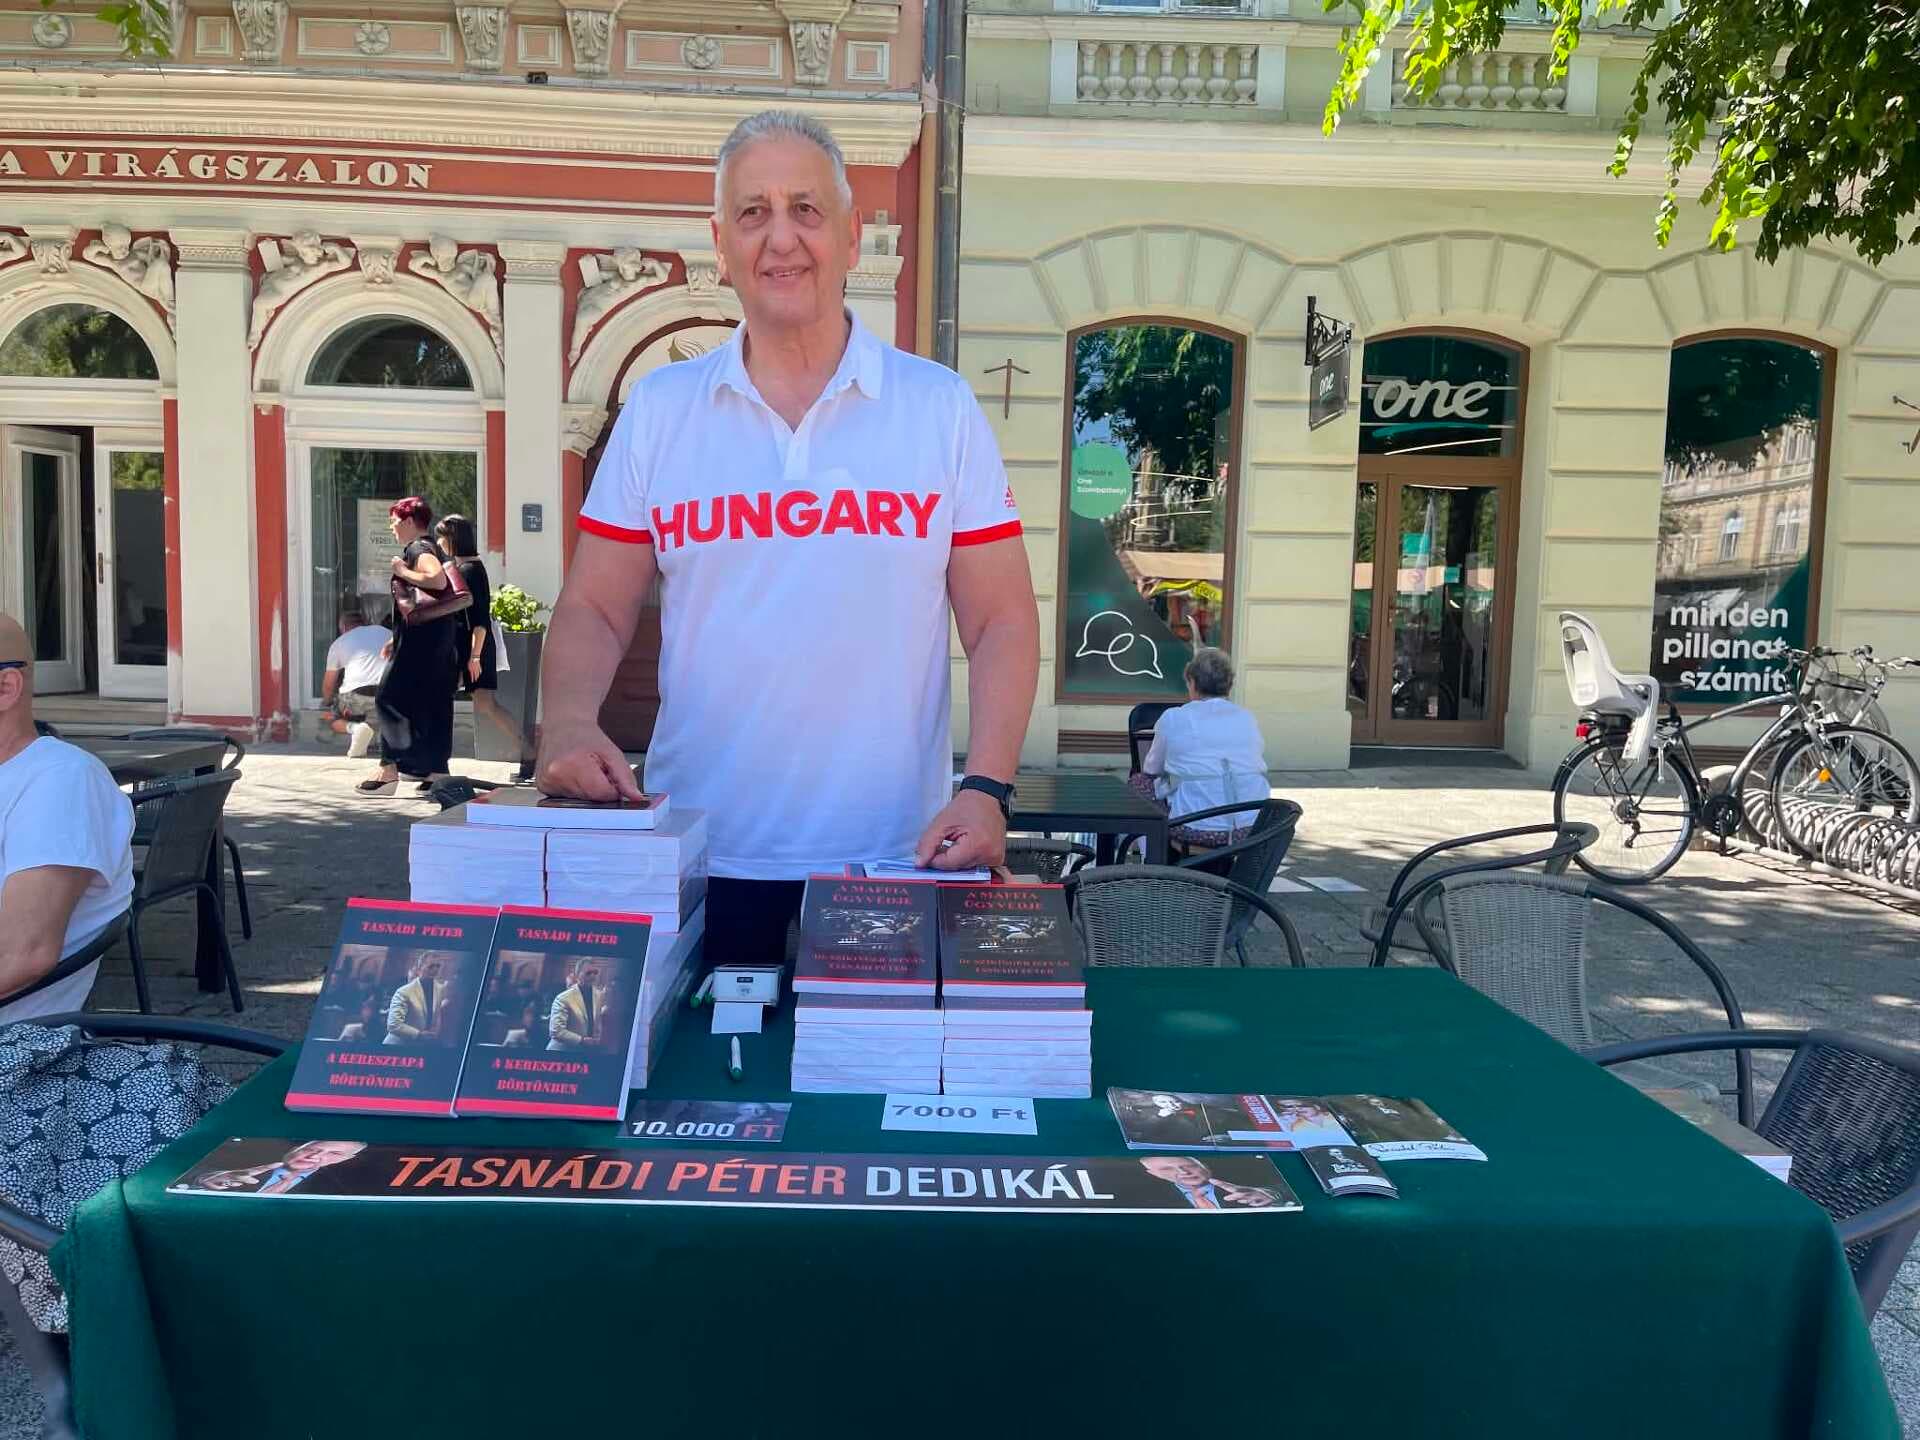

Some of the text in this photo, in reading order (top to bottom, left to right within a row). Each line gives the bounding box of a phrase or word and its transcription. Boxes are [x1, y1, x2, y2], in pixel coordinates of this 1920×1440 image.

[46, 148, 433, 189] VIRÁGSZALON
[1320, 372, 1334, 396] one
[1373, 379, 1491, 419] one
[651, 489, 943, 552] HUNGARY
[1670, 600, 1788, 629] minden
[1662, 632, 1787, 664] pillanat
[1680, 665, 1787, 692] számít
[361, 920, 464, 938] TASNÁDI PÉTER
[517, 927, 619, 945] TASNÁDI PÉTER
[326, 1053, 425, 1069] A KERESZTAPA
[492, 1058, 590, 1075] A KERESZTAPA
[892, 1104, 1029, 1121] 7000 Ft
[631, 1119, 780, 1139] 10.000 FT
[388, 1154, 1115, 1200] TASNÁDI PÉTER DEDIKÁL
